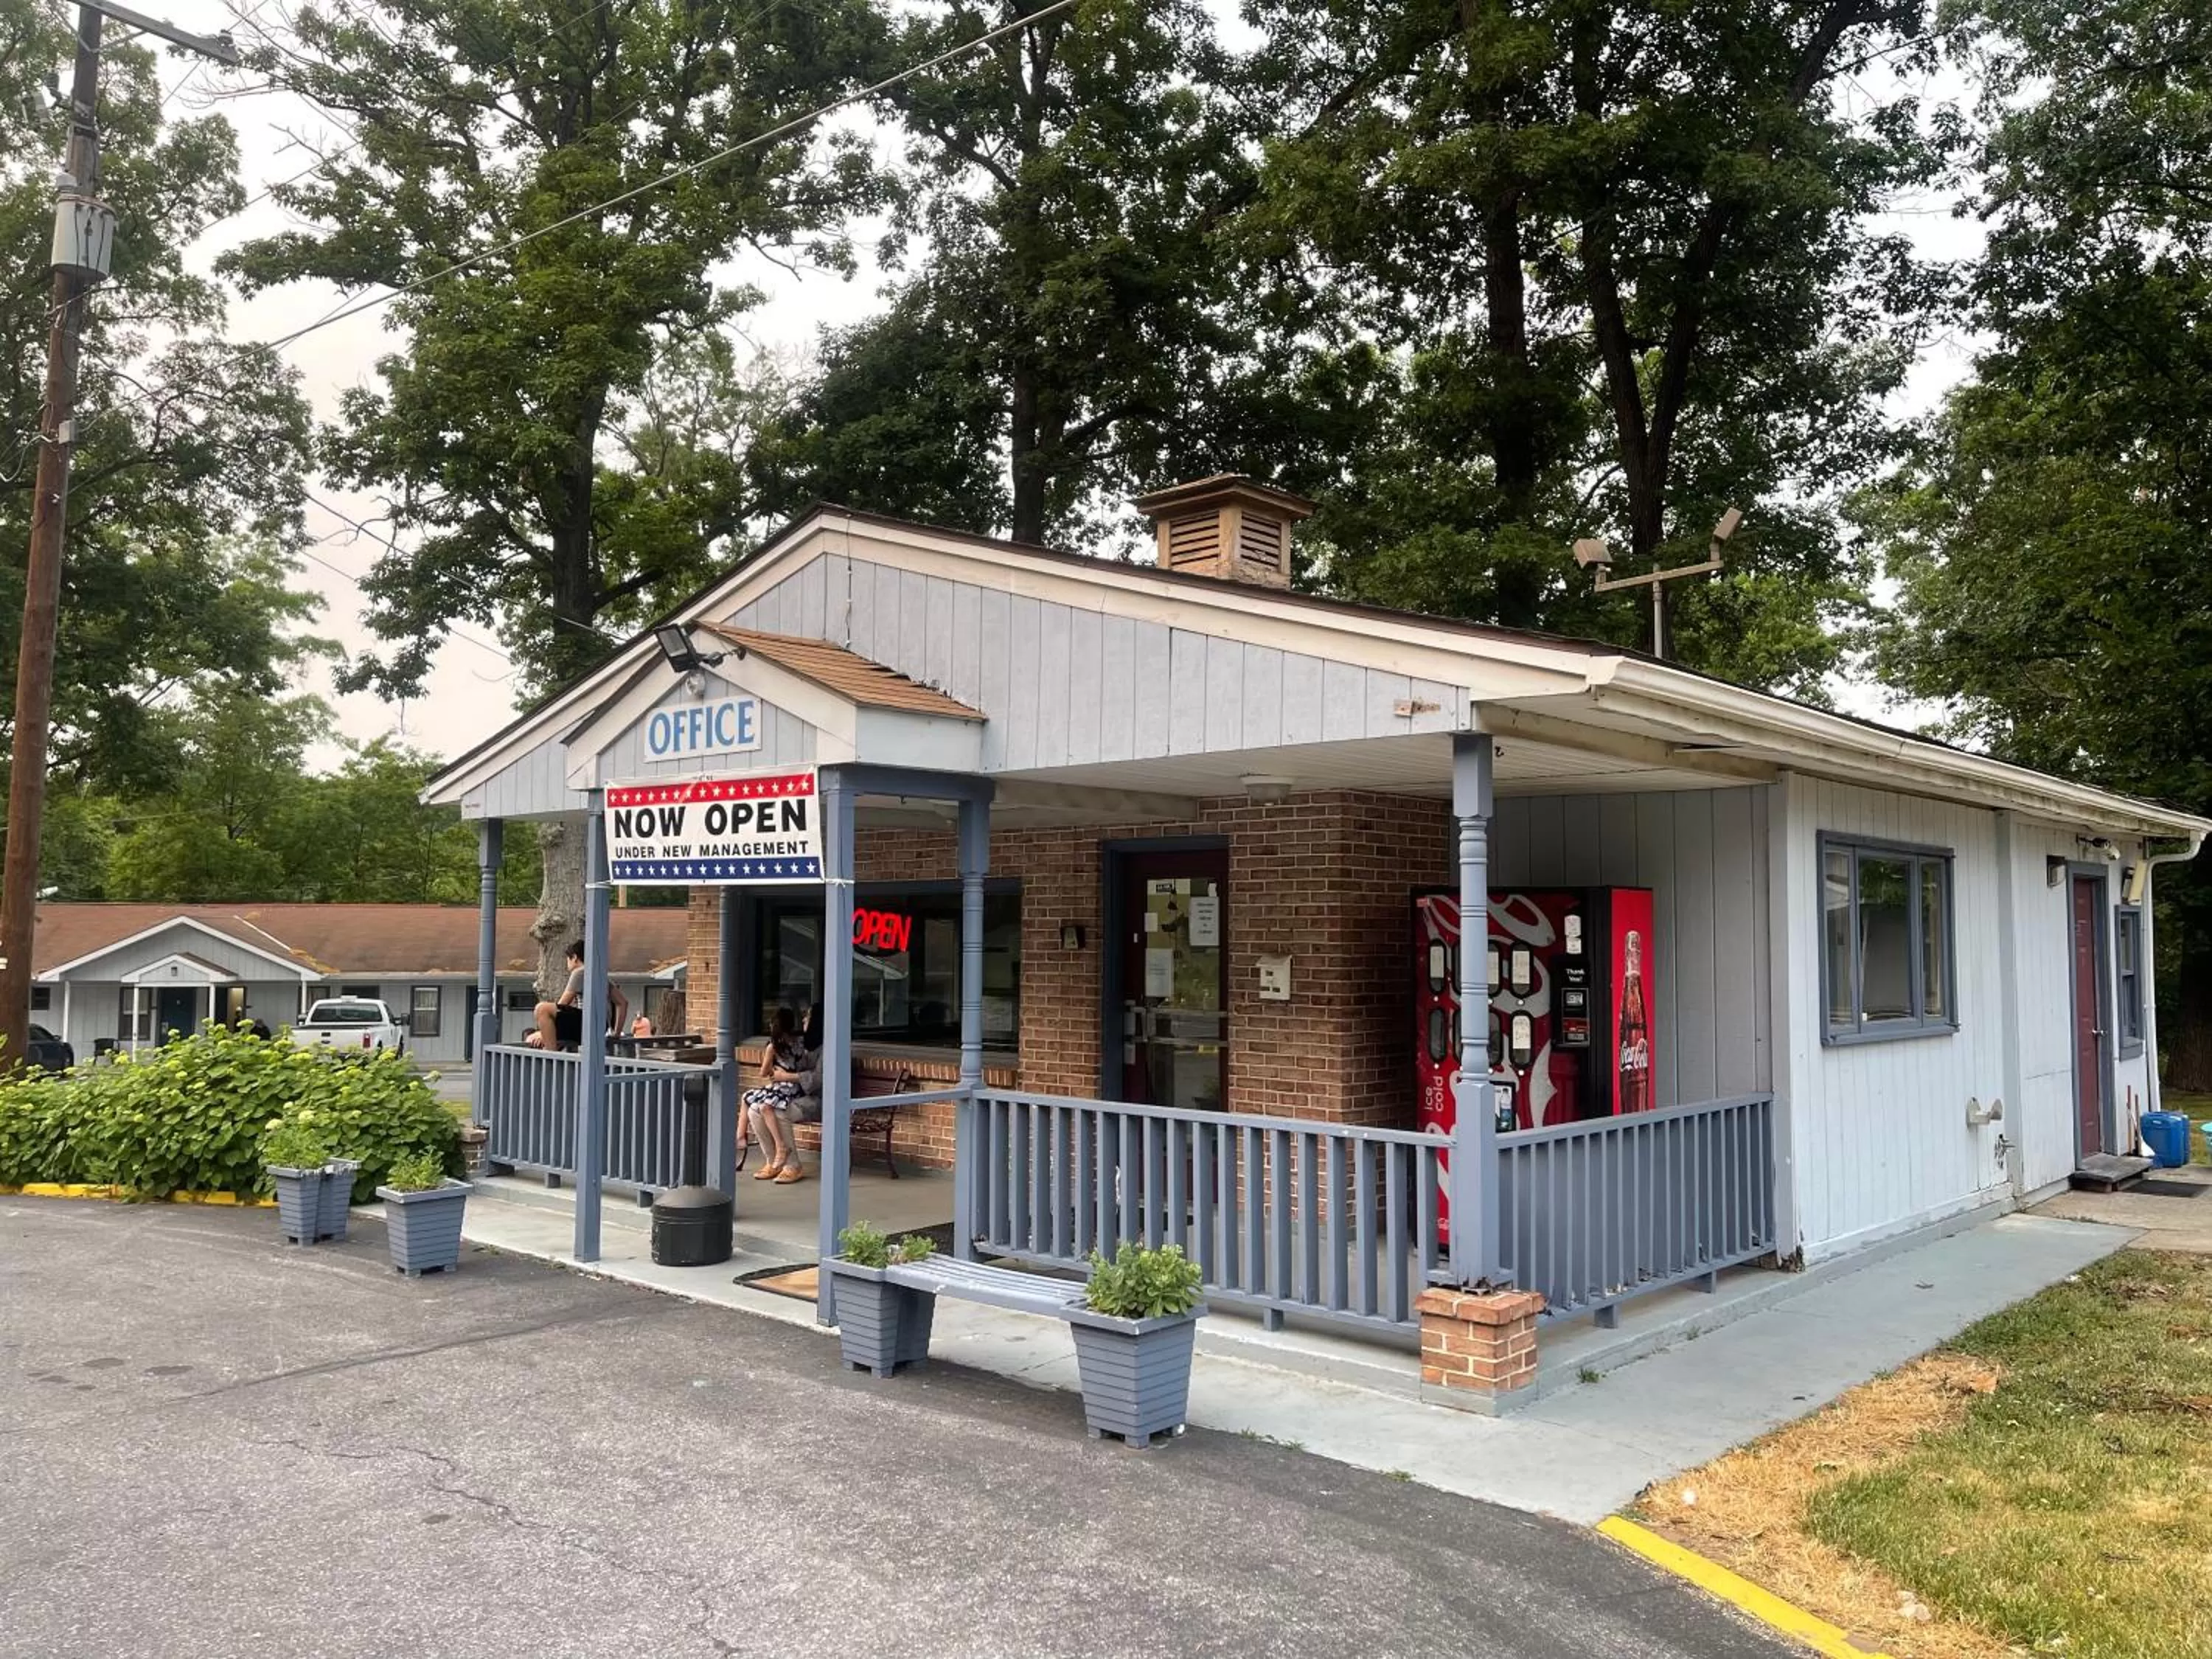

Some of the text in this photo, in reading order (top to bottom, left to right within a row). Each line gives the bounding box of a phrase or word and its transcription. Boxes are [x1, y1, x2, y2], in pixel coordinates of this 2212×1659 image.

[648, 700, 755, 755] OFFICE
[614, 799, 807, 838] NOW OPEN
[616, 841, 809, 858] UNDER NEW MANAGEMENT
[852, 908, 912, 953] OPEN
[1424, 1086, 1433, 1110] ice
[1433, 1076, 1444, 1112] cold
